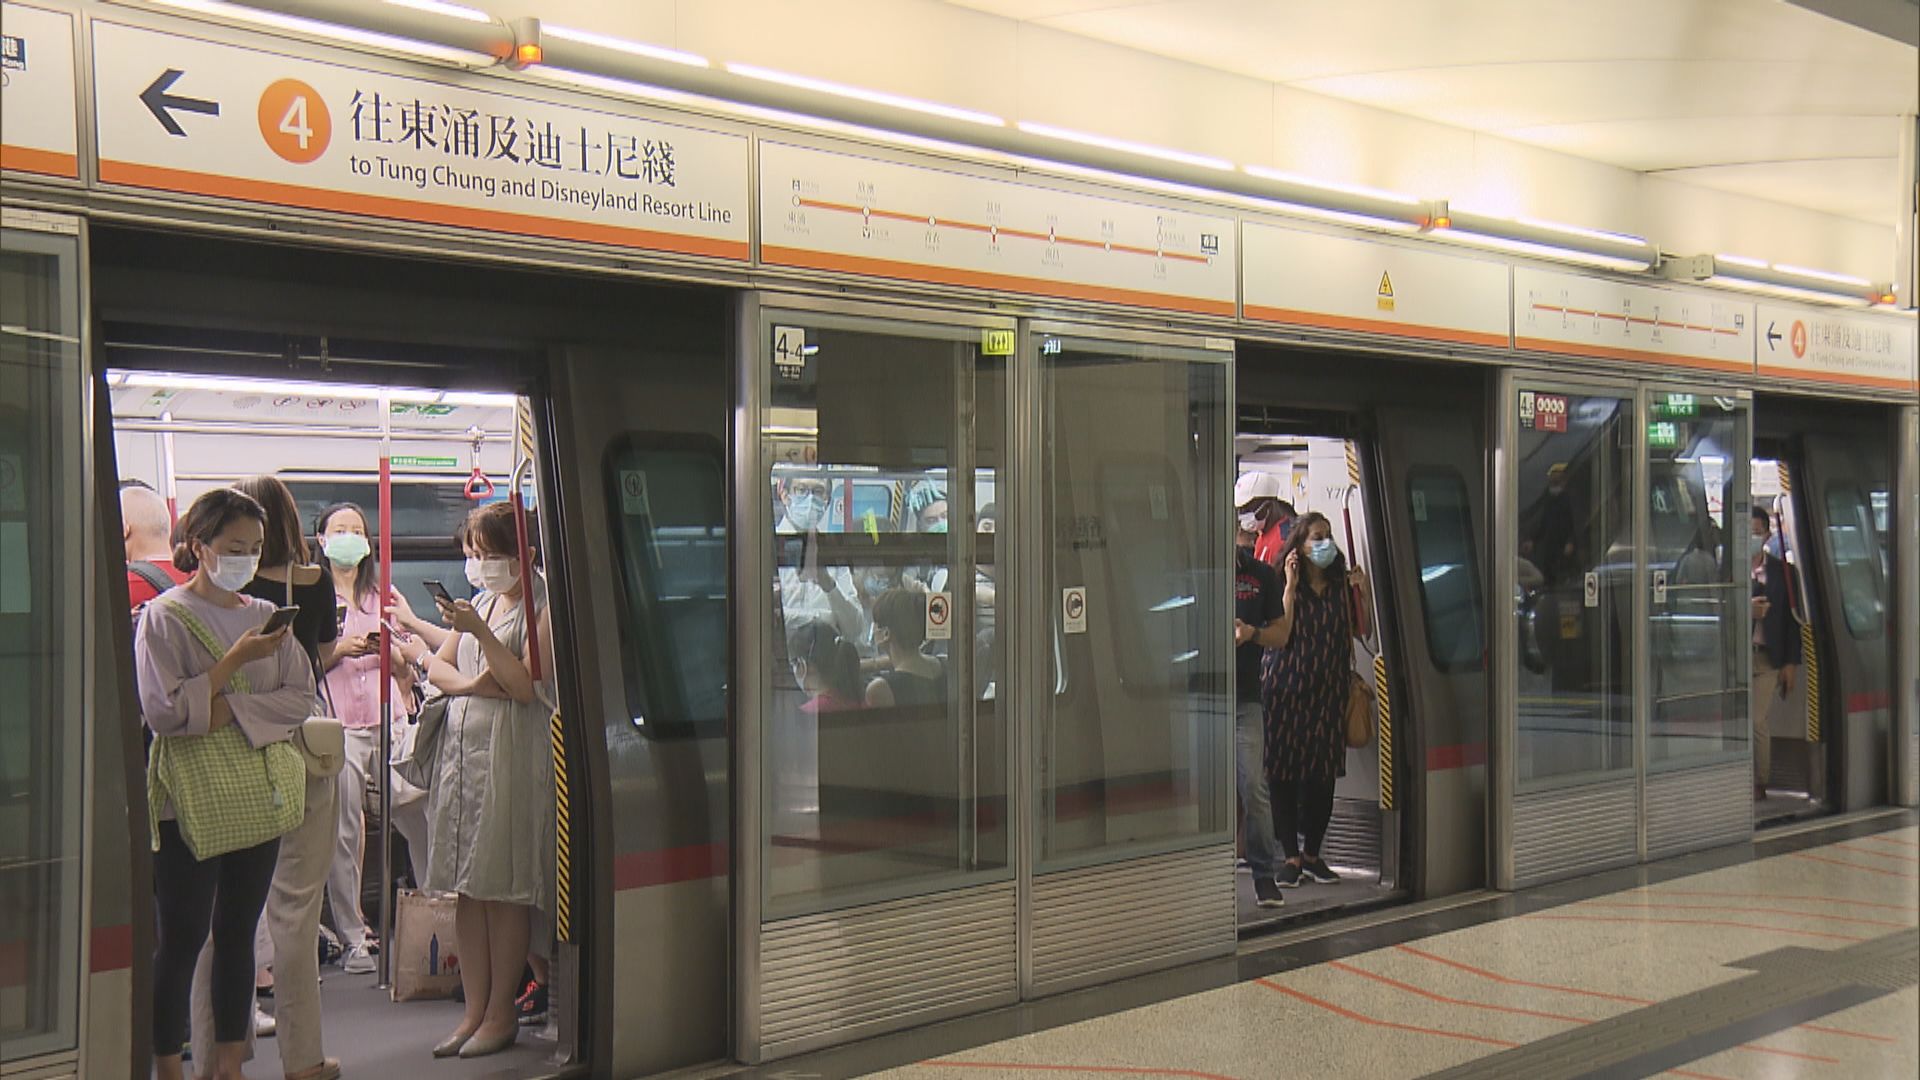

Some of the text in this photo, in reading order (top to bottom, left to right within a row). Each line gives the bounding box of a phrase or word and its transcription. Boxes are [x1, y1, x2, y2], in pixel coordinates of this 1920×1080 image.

[279, 96, 313, 150] 4
[350, 89, 676, 187] 往東涌及迪士尼綫
[350, 155, 731, 224] to Tung Chung and Disneyland Resort Line
[776, 333, 803, 361] 4-4
[1794, 327, 1803, 353] 4
